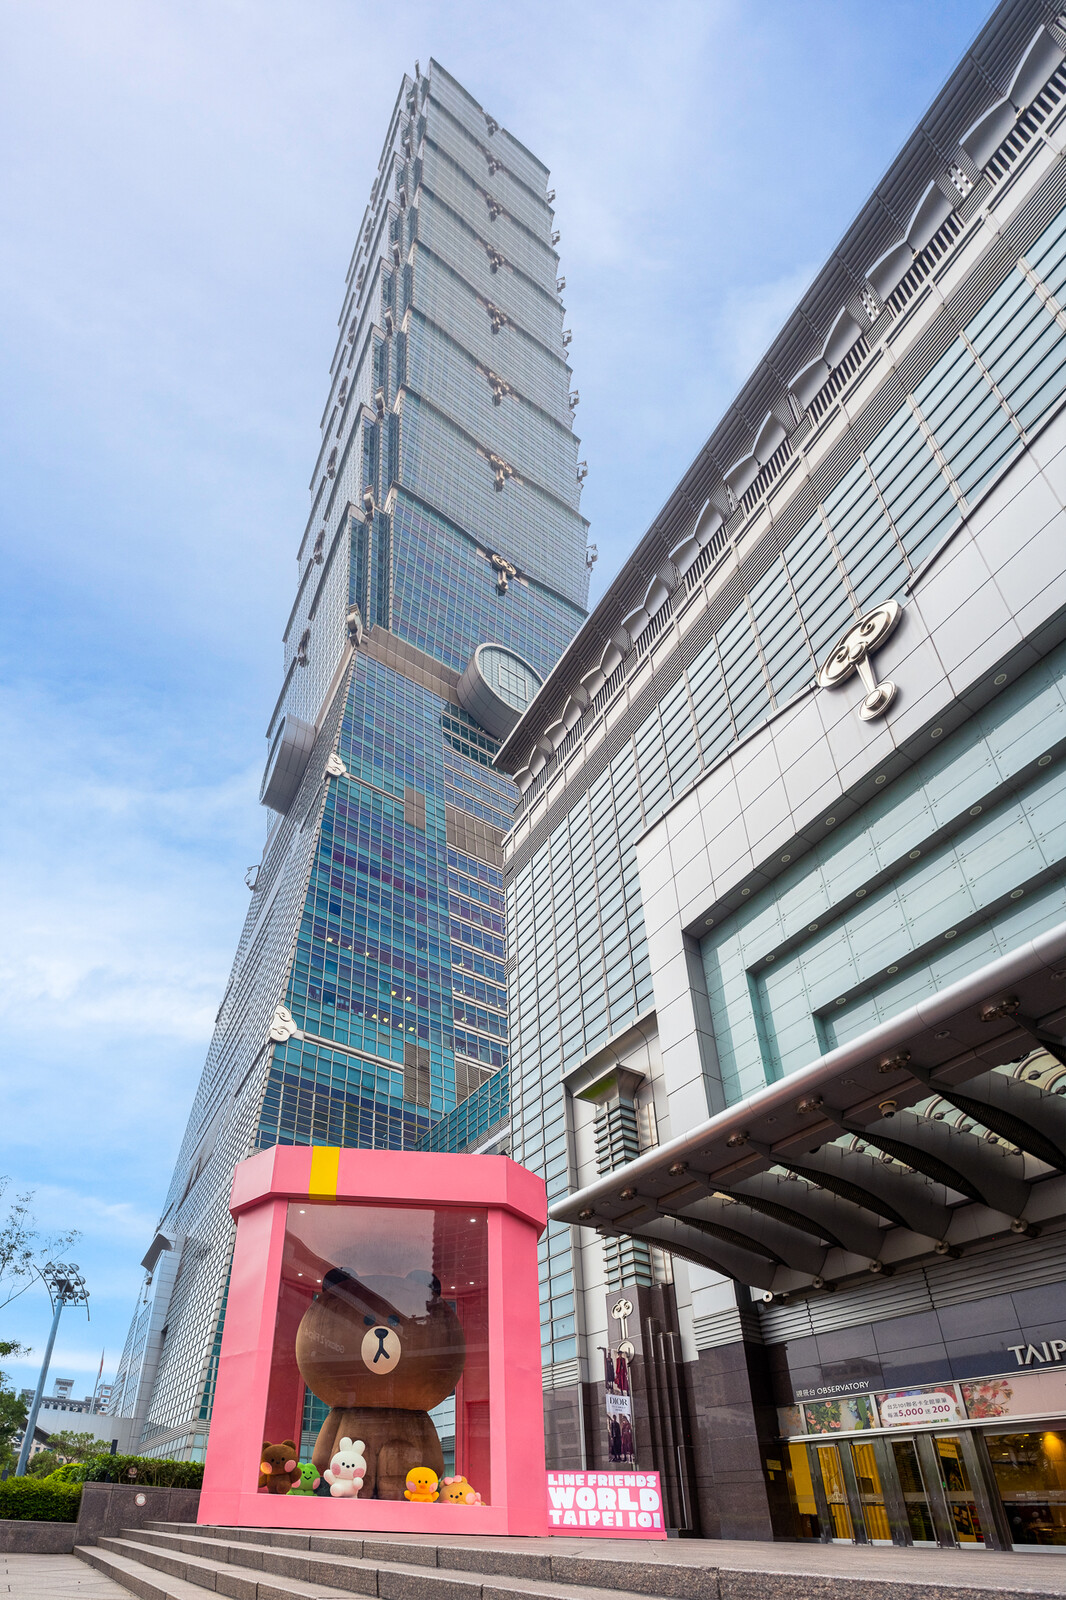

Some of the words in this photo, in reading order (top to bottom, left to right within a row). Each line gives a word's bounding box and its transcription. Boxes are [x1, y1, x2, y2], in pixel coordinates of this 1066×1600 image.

[816, 1381, 869, 1395] OBSERVATORY
[609, 1396, 628, 1406] DIOR
[931, 1404, 951, 1414] 200
[547, 1473, 585, 1486] LINE
[587, 1474, 657, 1488] FRIENDS
[548, 1486, 660, 1512] WORLD
[549, 1509, 624, 1527] TAIPEI
